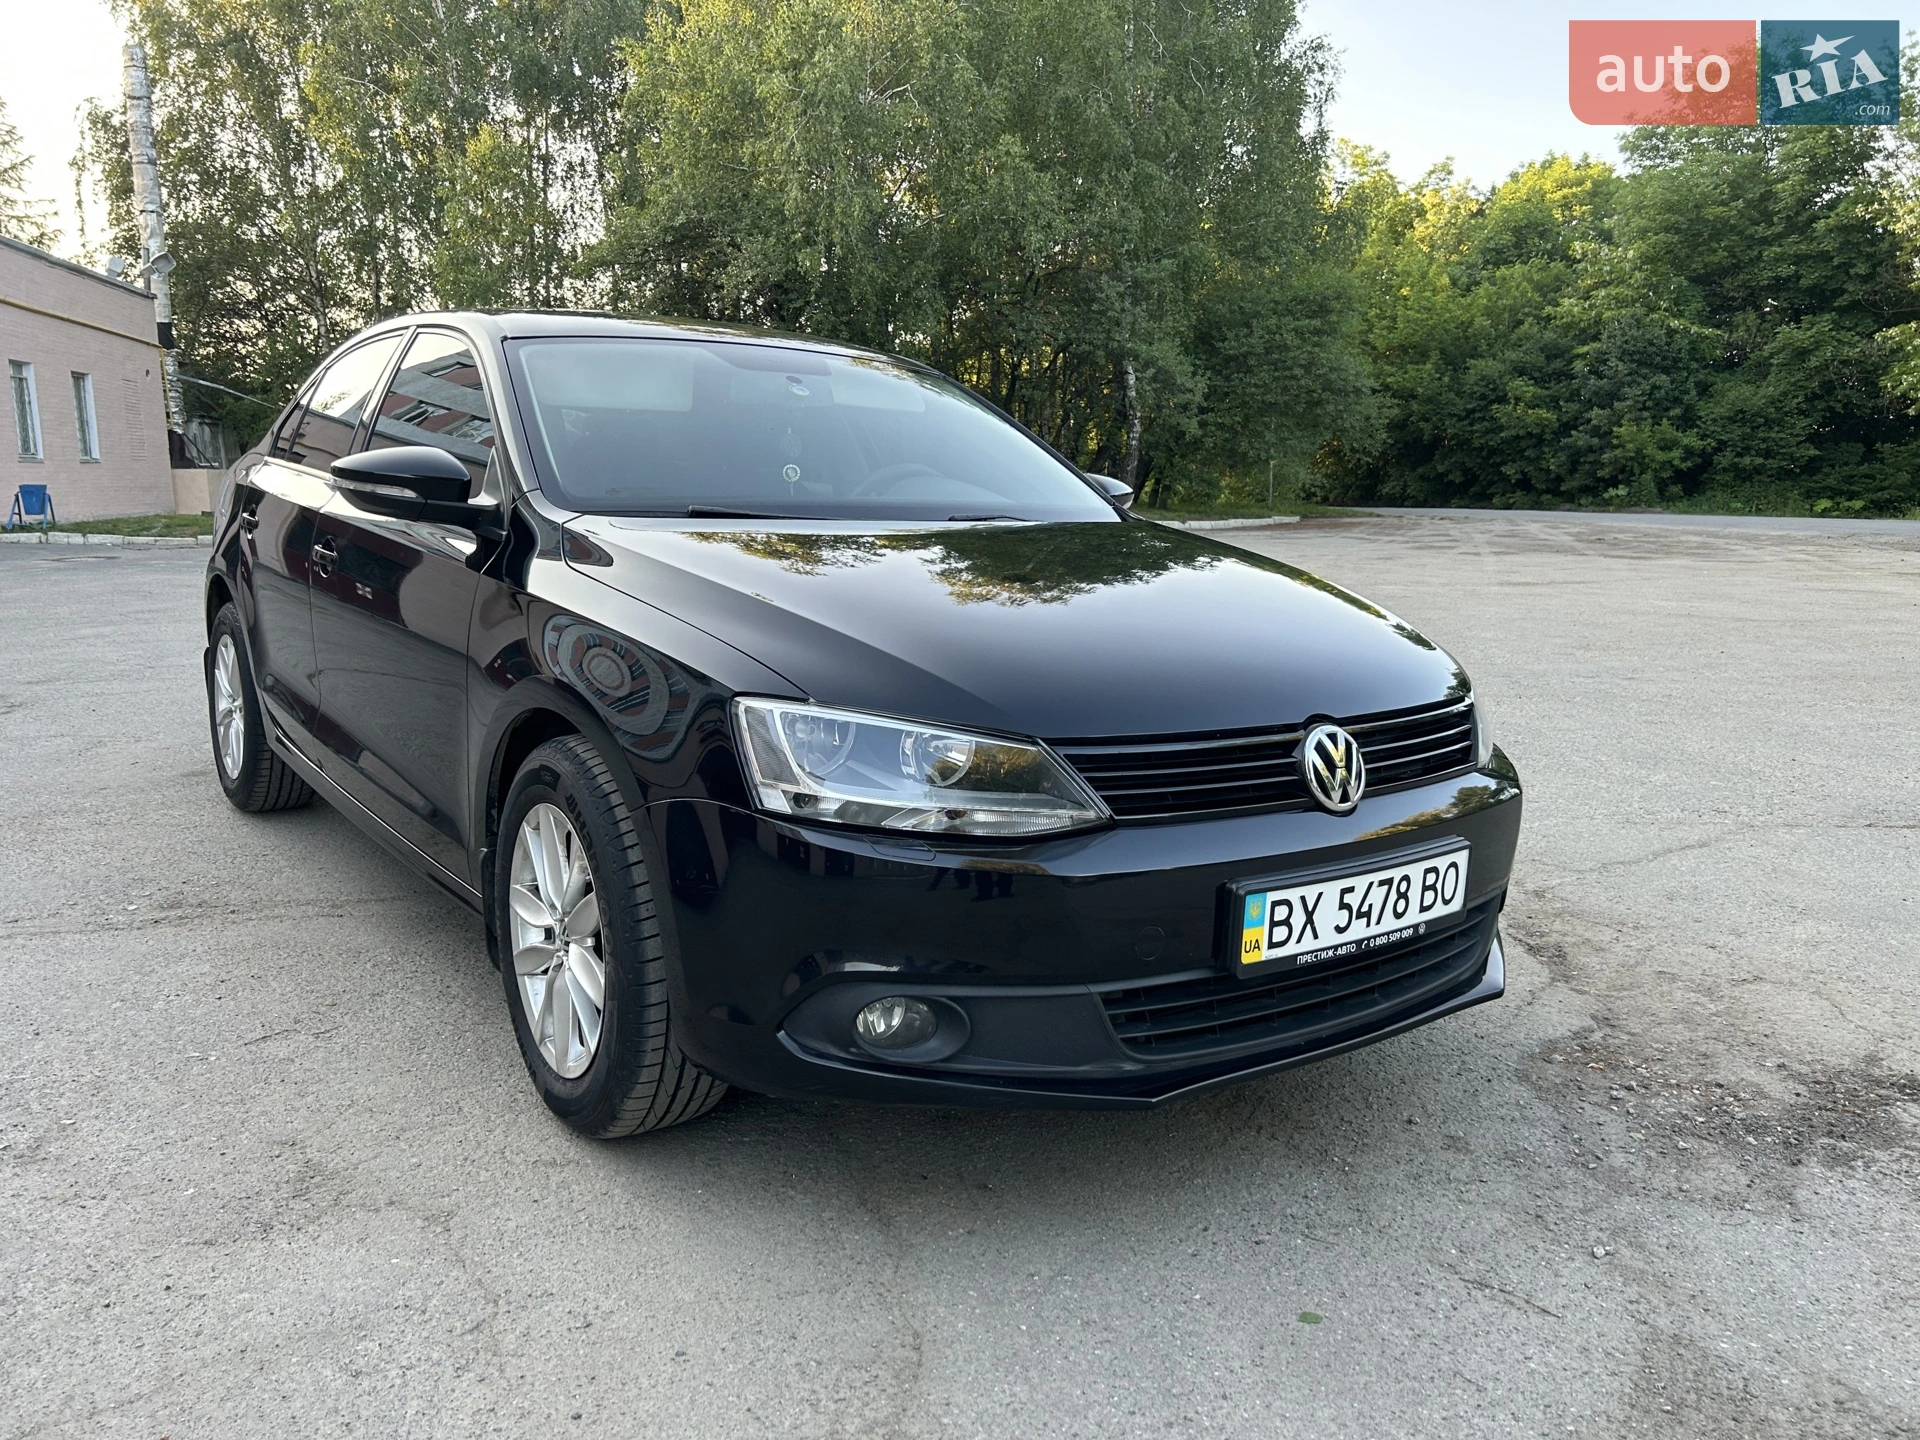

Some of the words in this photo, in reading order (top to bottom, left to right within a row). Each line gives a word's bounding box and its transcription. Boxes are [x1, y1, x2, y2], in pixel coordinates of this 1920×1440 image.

[1266, 891, 1324, 951] BX
[1333, 873, 1412, 935] 5478
[1418, 860, 1460, 914] BO
[1243, 938, 1261, 954] UA
[1296, 943, 1357, 965] ПРЕСТИЖ-АВТО
[1369, 938, 1376, 947] 0
[1375, 934, 1388, 946] 800
[1388, 931, 1401, 942] 509
[1401, 927, 1414, 939] 009
